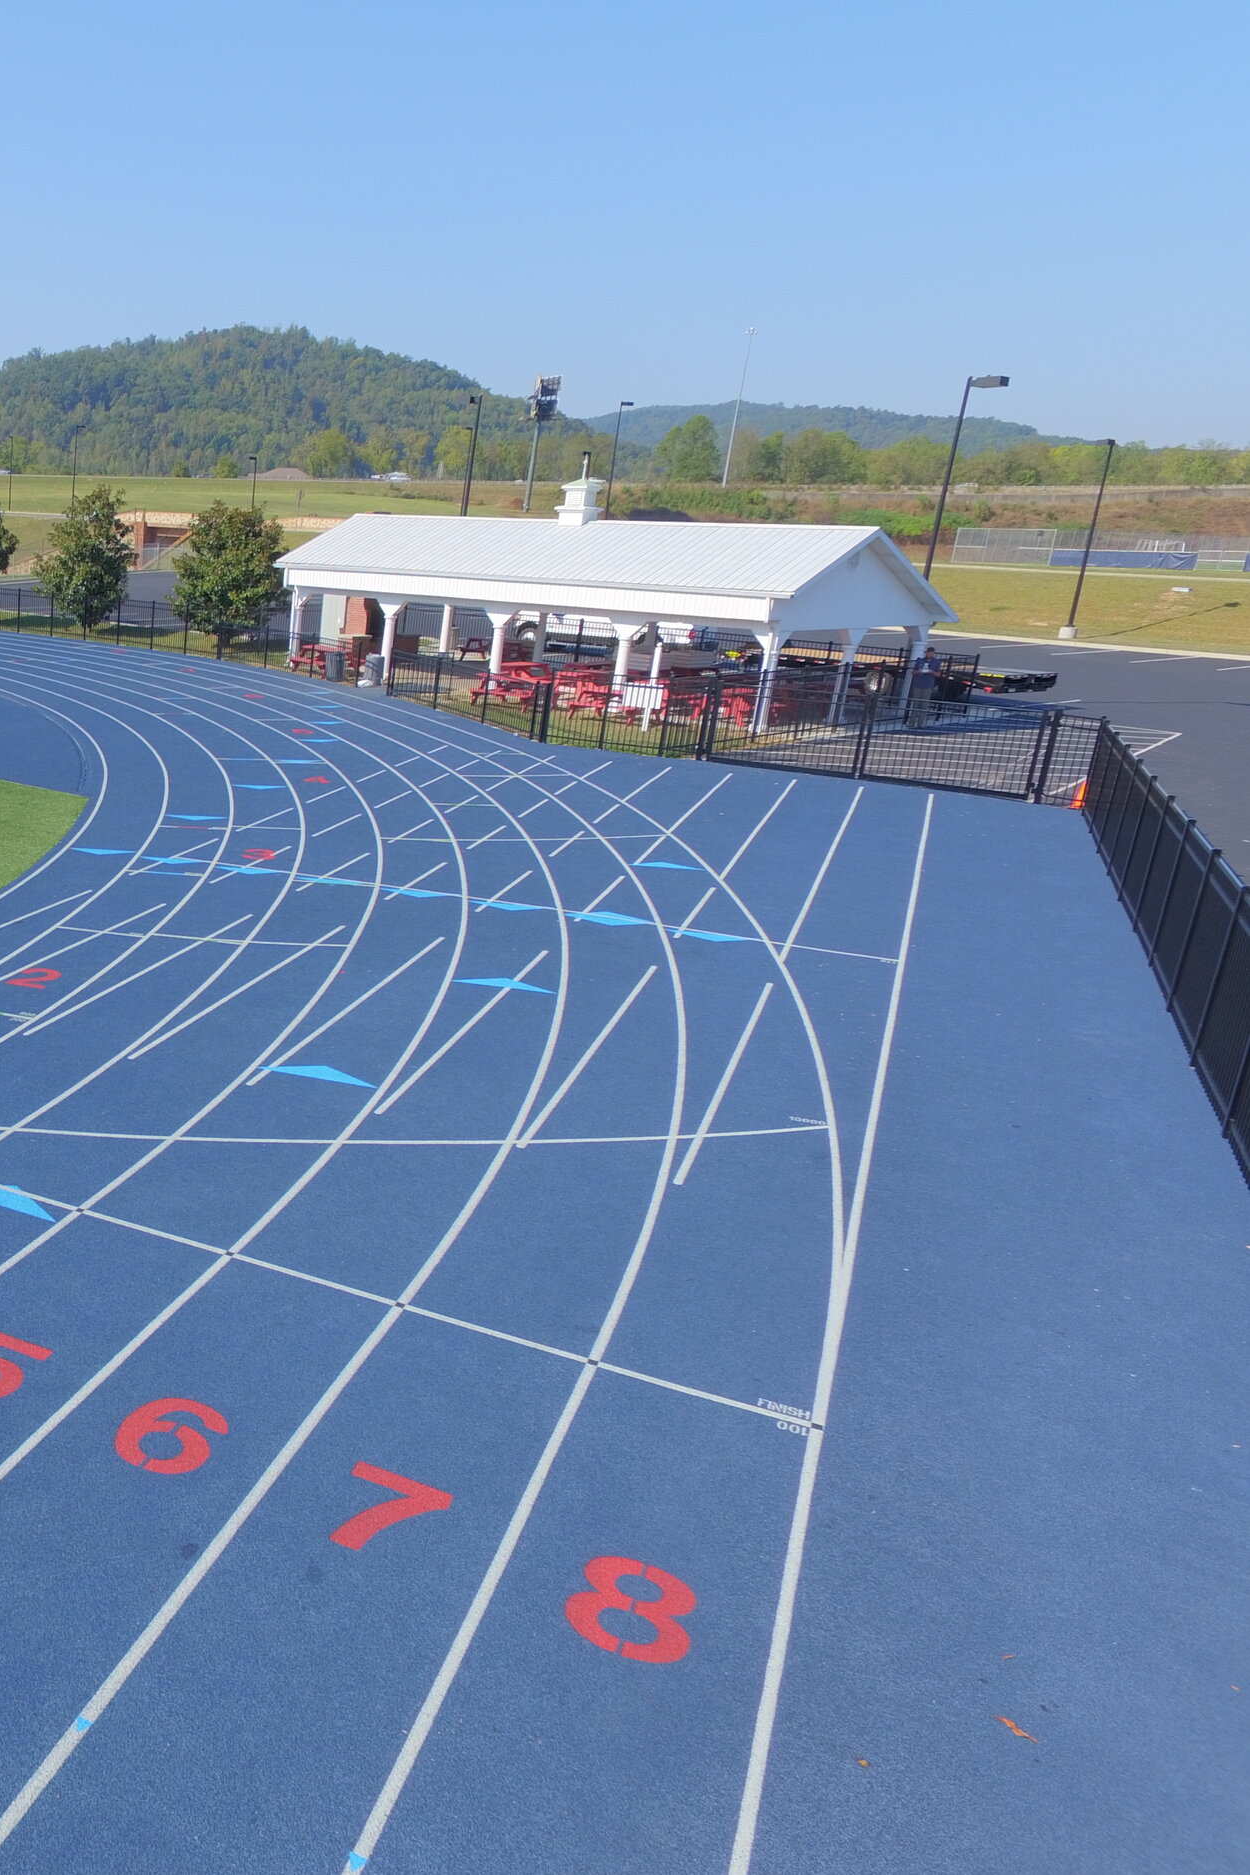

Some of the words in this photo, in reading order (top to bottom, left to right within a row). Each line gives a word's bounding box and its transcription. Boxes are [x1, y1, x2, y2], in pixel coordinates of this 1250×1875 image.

[241, 848, 276, 860] 3
[5, 967, 62, 989] 2
[757, 1397, 811, 1420] FINISH
[114, 1397, 229, 1475] 6
[329, 1461, 454, 1551] 7
[564, 1555, 697, 1664] 8
